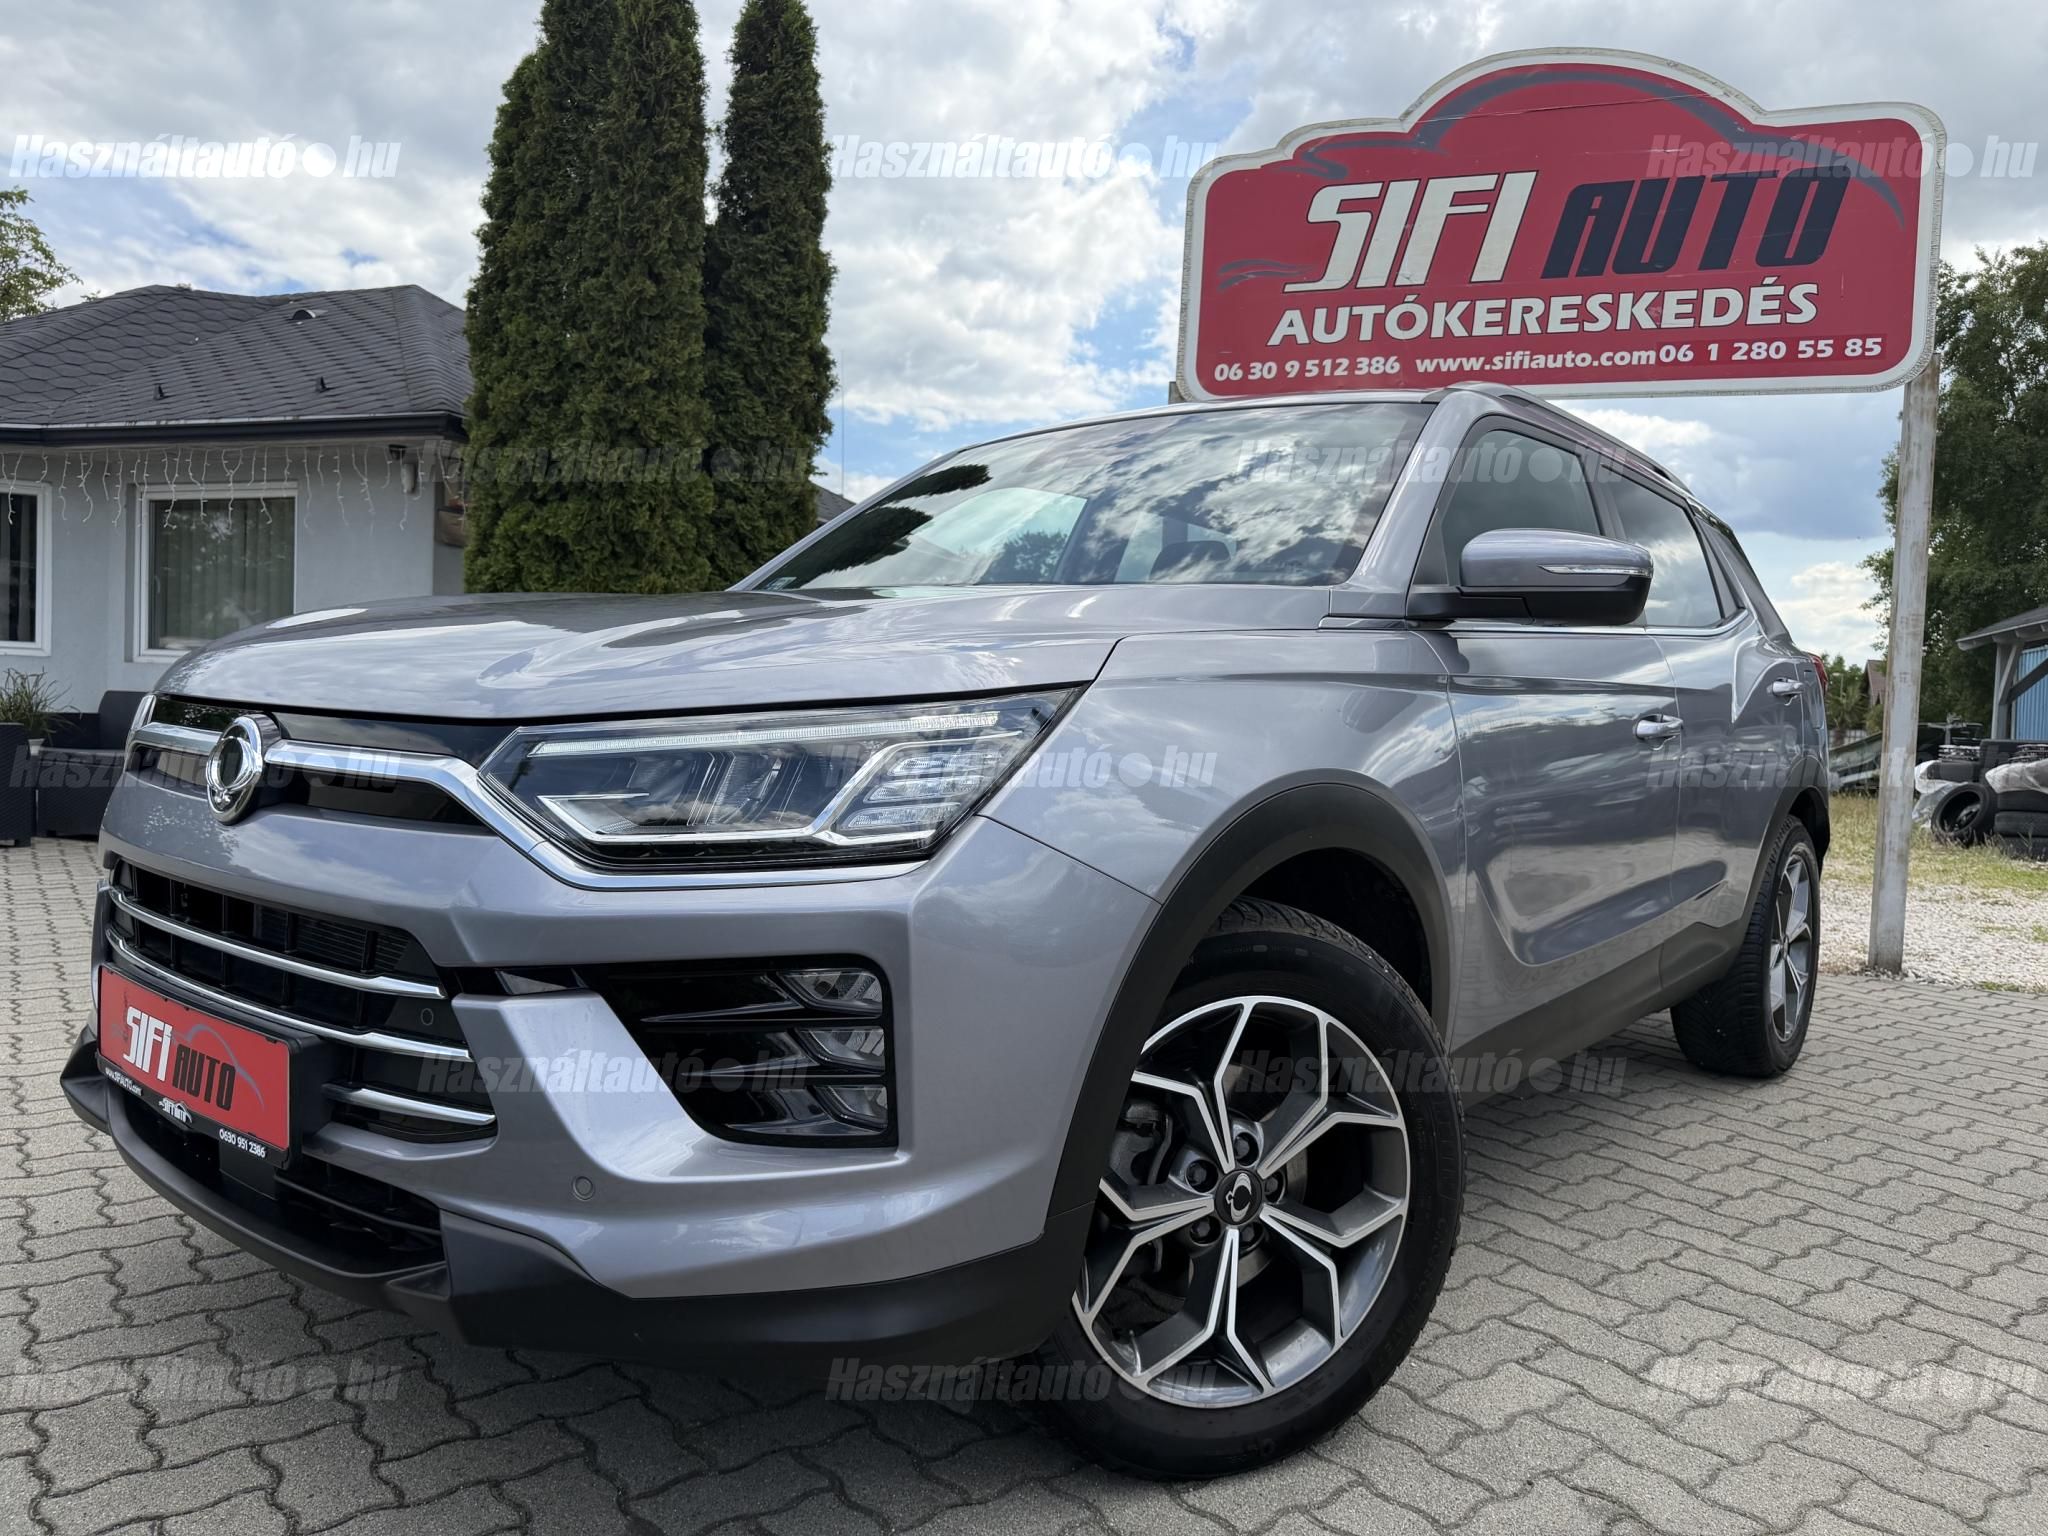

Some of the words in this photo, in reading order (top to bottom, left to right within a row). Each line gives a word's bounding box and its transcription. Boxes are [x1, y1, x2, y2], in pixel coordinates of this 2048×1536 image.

[1283, 171, 1537, 293] SIFI
[1540, 167, 1851, 280] AUTO
[1267, 277, 1818, 346] AUTÓKERESKEDÉS
[1214, 363, 1243, 381] 06
[1247, 361, 1277, 380] 30
[1284, 360, 1300, 378] 9
[1304, 358, 1349, 377] 512
[1354, 356, 1400, 375] 386
[1415, 349, 1656, 373] www.sifiauto.com
[1659, 344, 1694, 363] 06
[1707, 343, 1719, 361] 1
[1731, 341, 1787, 361] 280
[1797, 339, 1833, 358] 55
[1844, 337, 1882, 357] 85
[123, 1006, 173, 1082] SIFI
[172, 1043, 236, 1112] AUTO
[219, 1128, 237, 1145] 0630
[237, 1136, 248, 1151] 951
